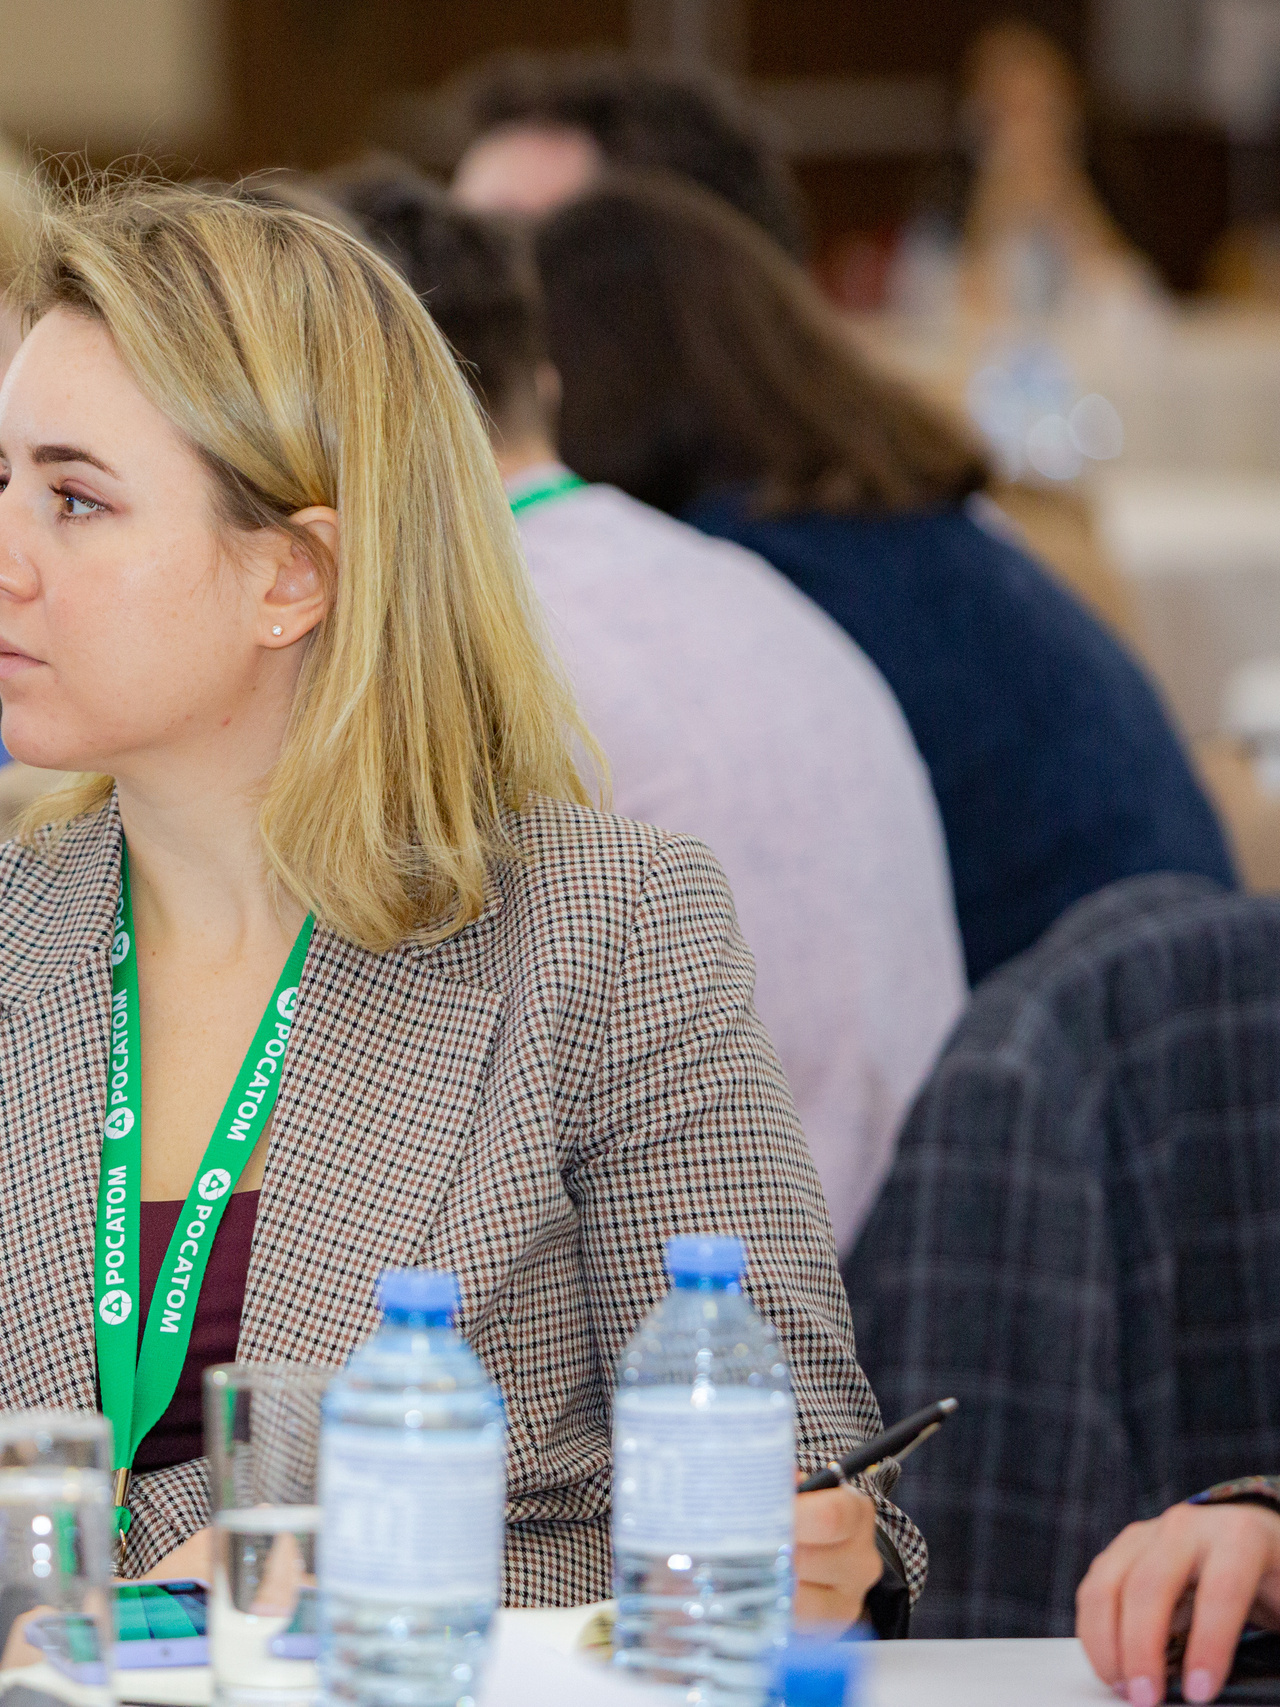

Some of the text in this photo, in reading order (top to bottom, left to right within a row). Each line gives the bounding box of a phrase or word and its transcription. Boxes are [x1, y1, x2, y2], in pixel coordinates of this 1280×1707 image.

[111, 988, 128, 1105] РОСАТОМ
[226, 1022, 291, 1141] РОСАТОМ
[105, 1165, 126, 1285] РОСАТОМ
[160, 1204, 213, 1333] РОСАТОМ
